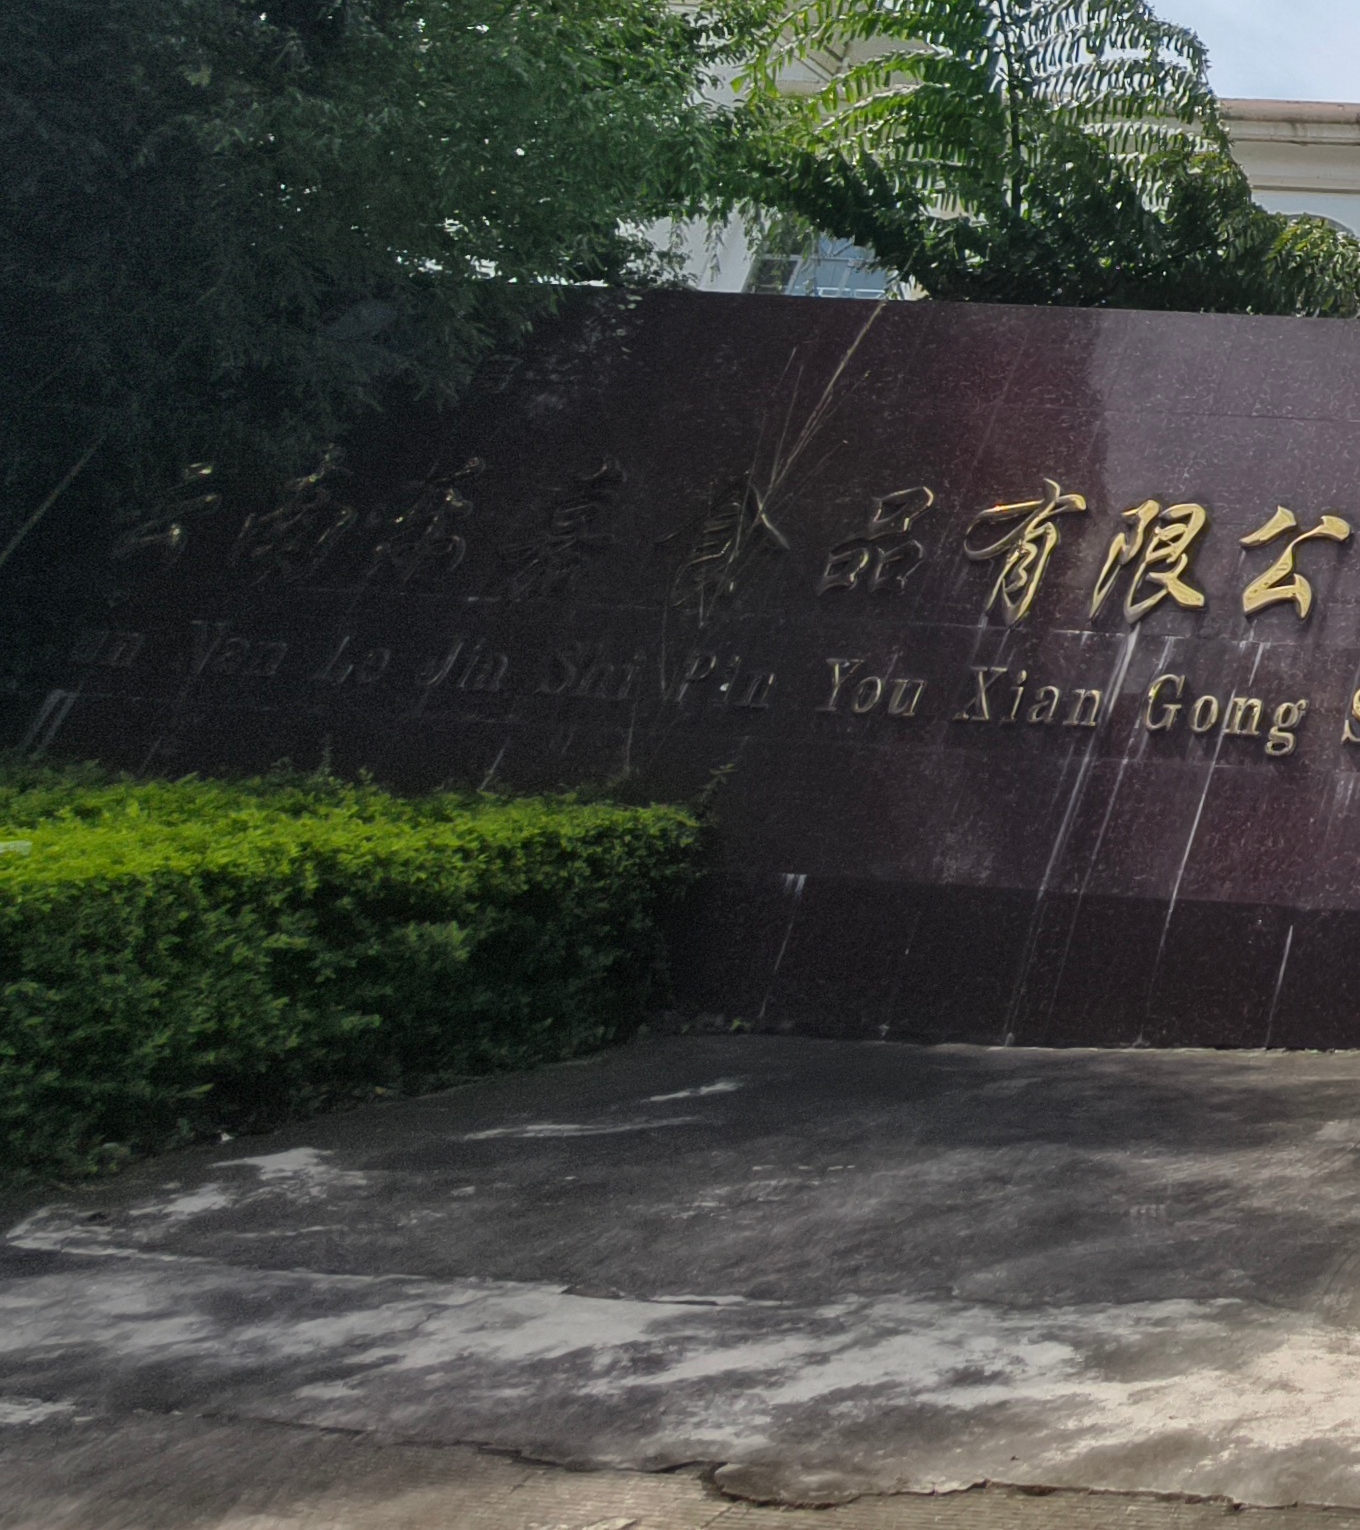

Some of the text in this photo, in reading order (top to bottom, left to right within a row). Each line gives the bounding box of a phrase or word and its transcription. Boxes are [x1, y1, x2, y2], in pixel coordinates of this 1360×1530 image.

[671, 647, 779, 710] Pin
[814, 657, 927, 719] You
[953, 664, 1104, 729] Xian
[1143, 672, 1308, 757] Gong
